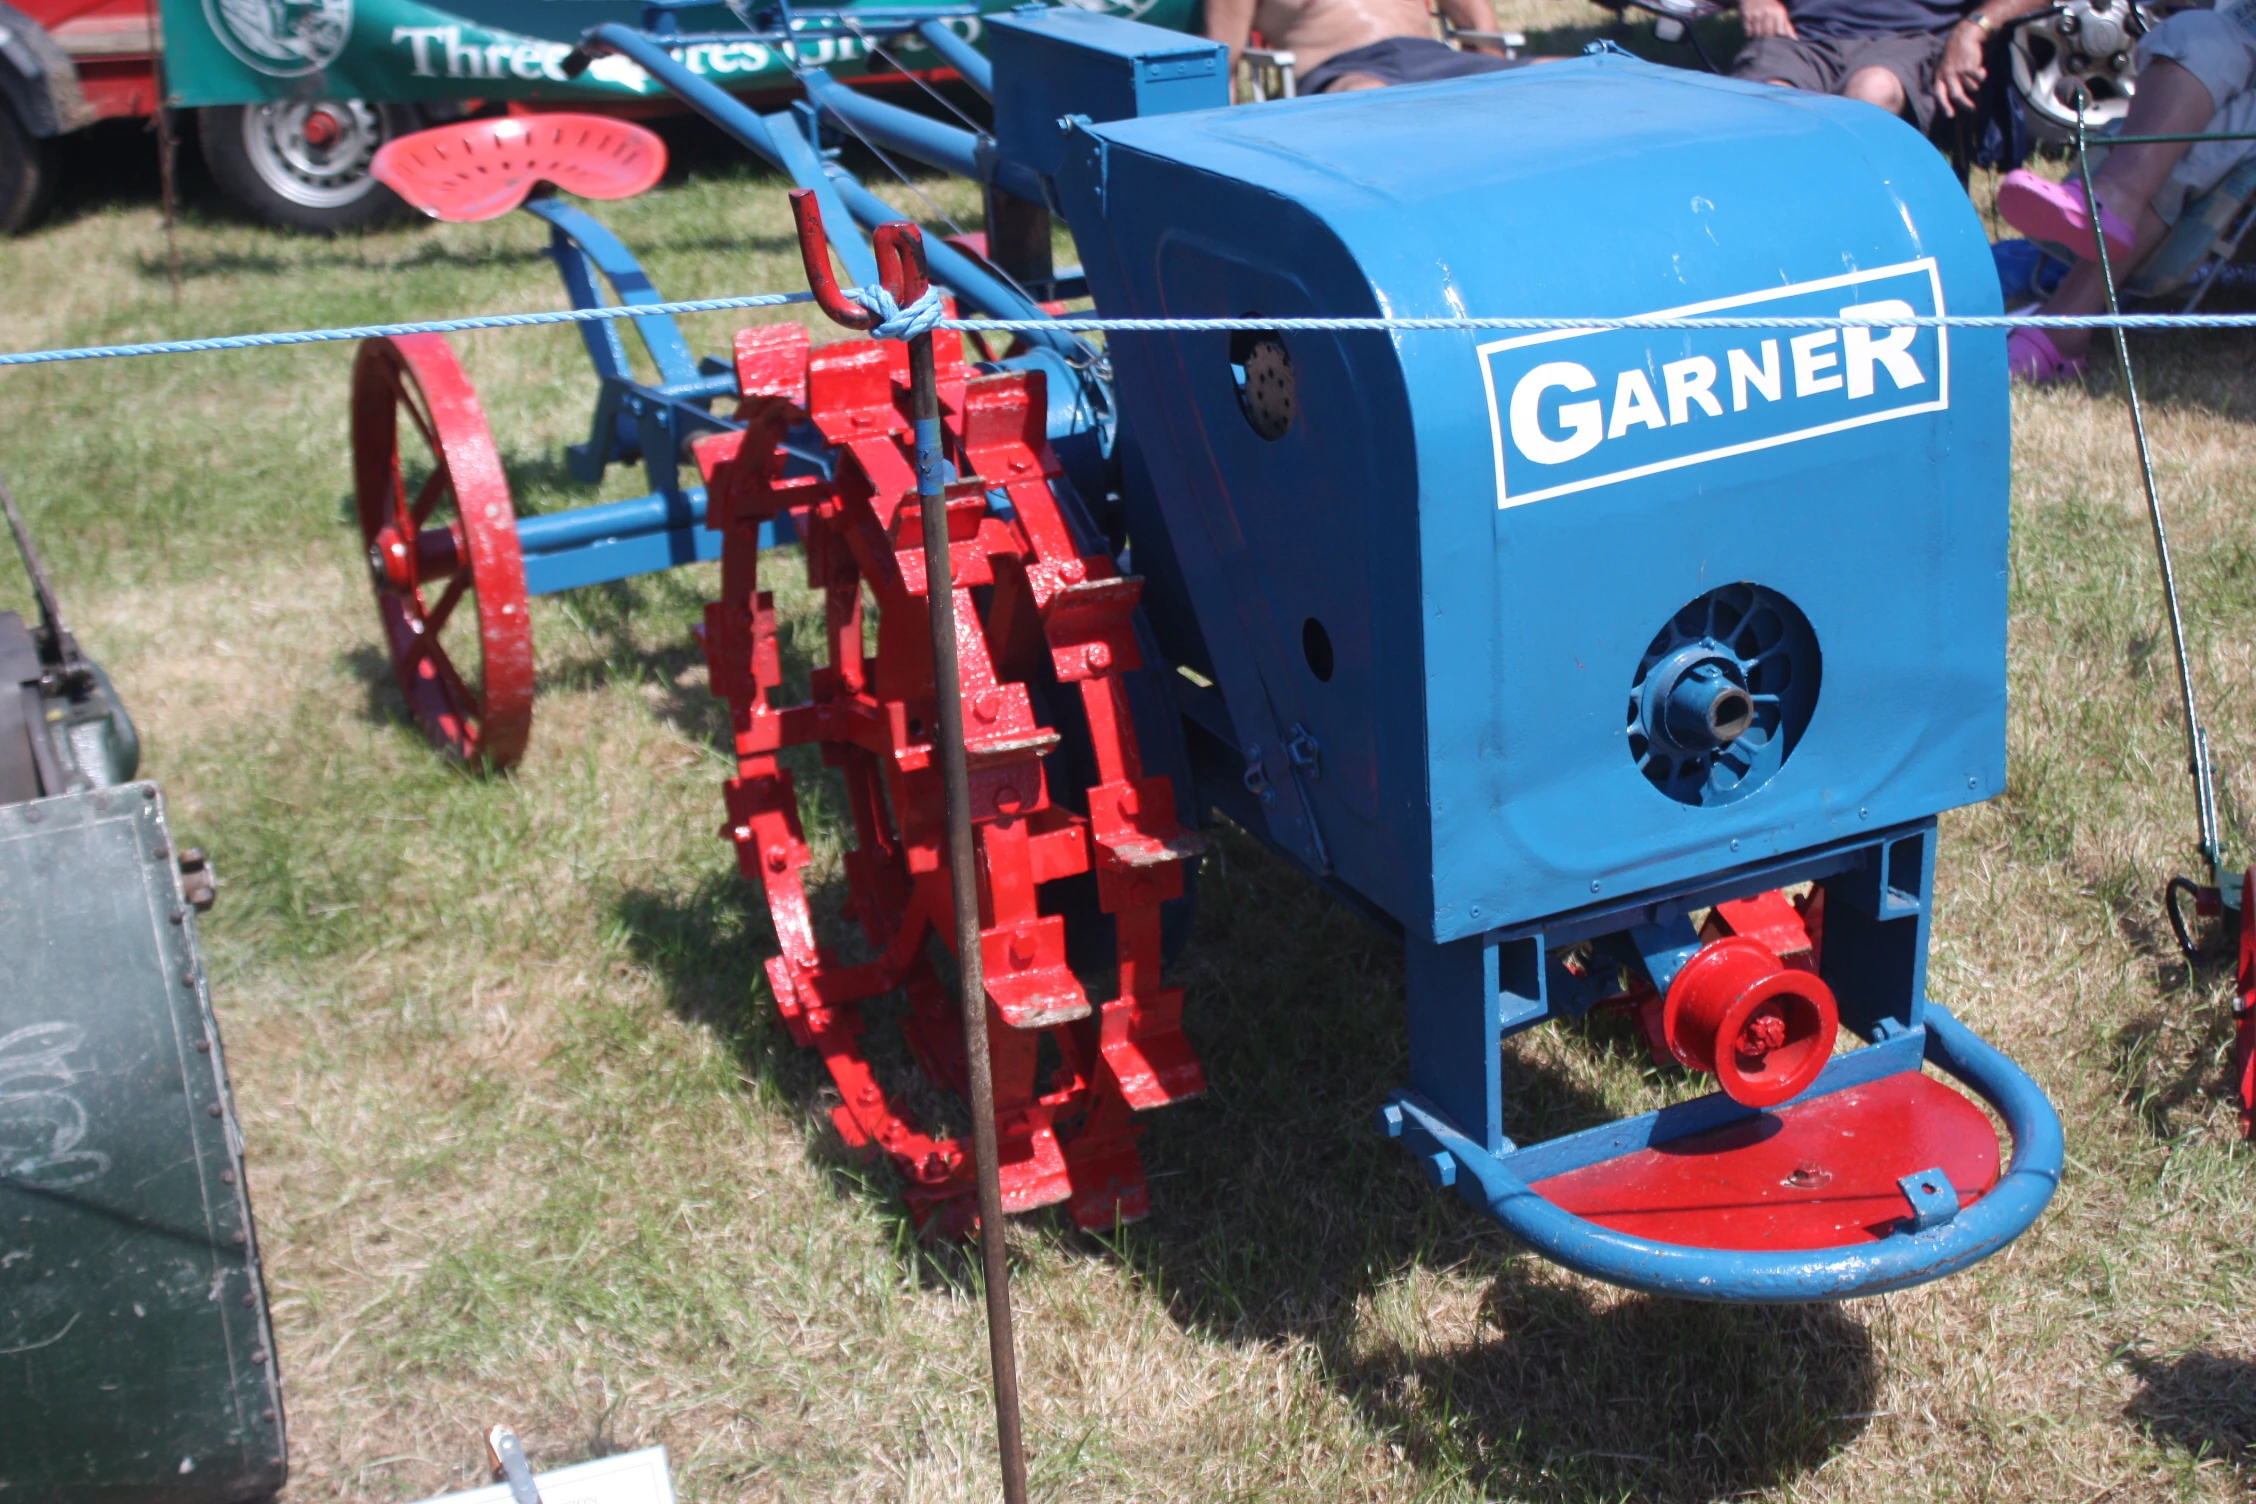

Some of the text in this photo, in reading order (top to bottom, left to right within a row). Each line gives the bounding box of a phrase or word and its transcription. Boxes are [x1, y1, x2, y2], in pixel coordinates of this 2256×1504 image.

[391, 15, 981, 93] Three res Grp
[1510, 299, 1925, 464] GARNER
